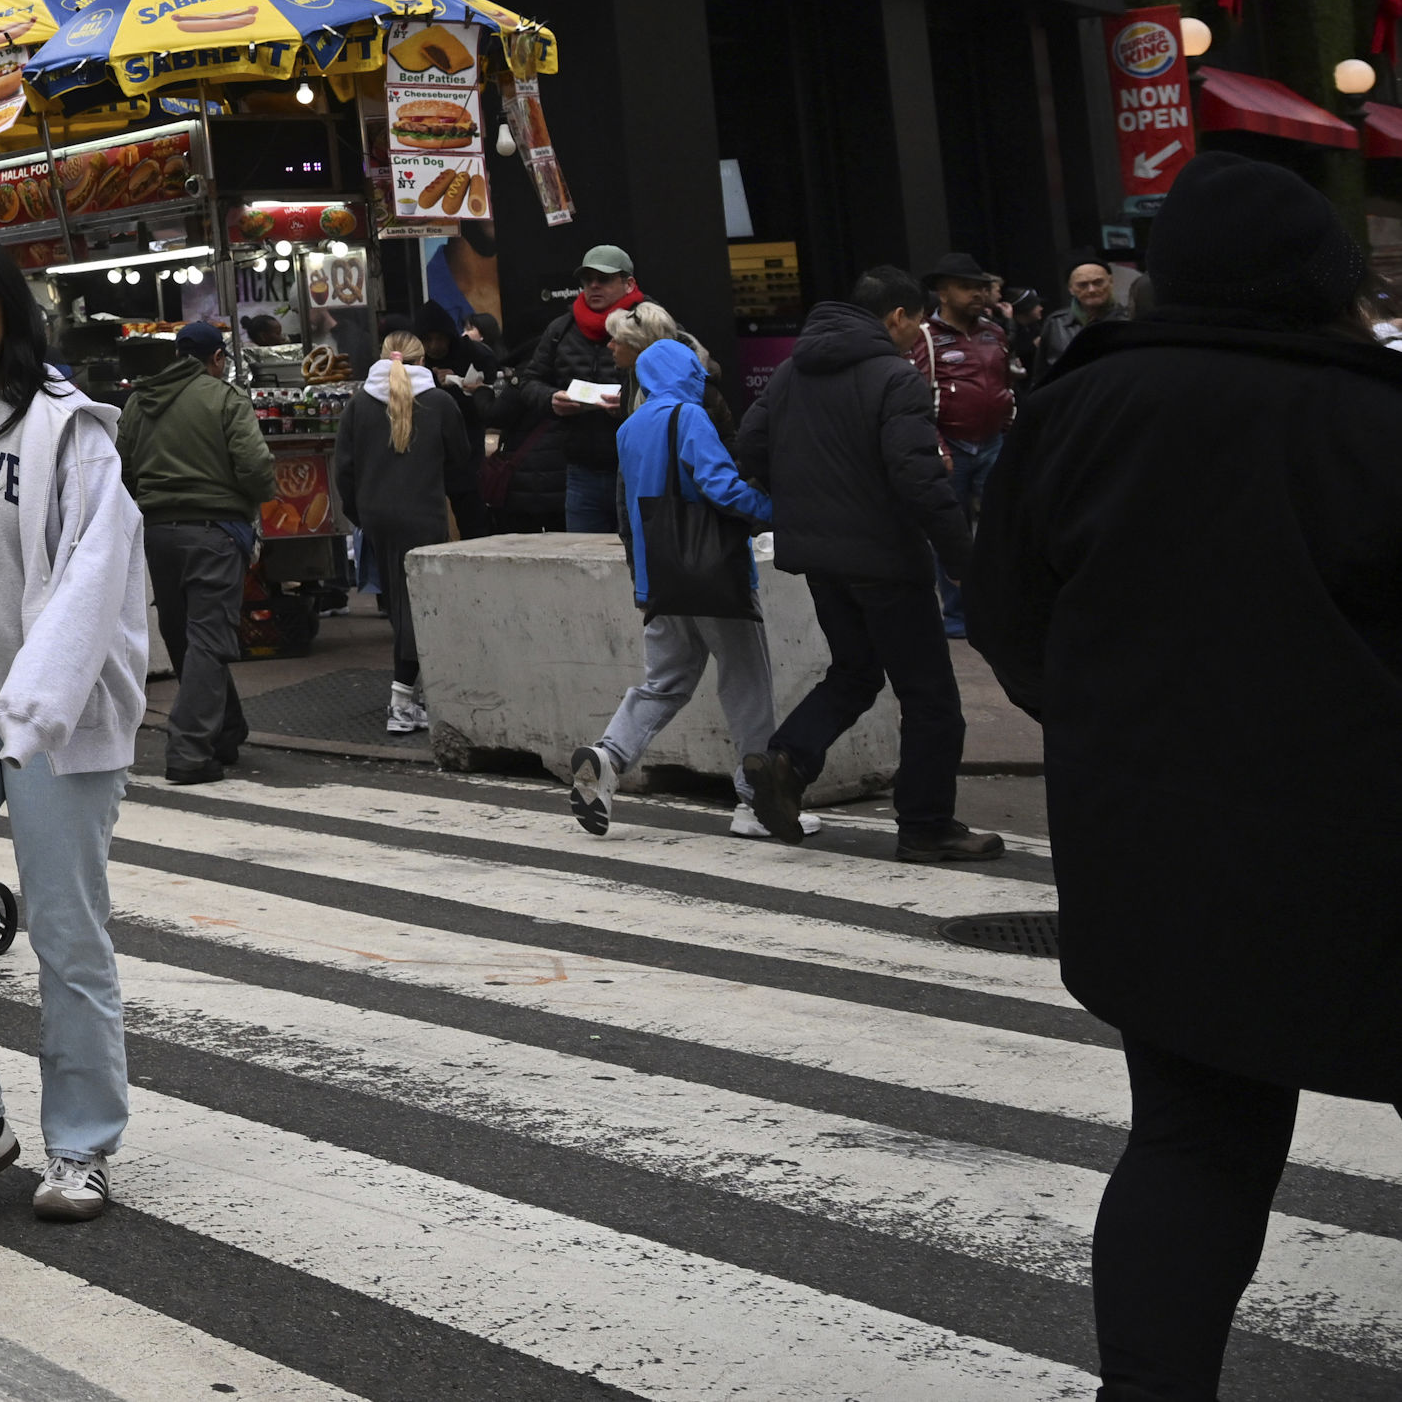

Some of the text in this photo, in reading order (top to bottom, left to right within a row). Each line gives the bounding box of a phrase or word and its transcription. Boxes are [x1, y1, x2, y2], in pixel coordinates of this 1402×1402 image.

[1120, 29, 1167, 55] BURGER
[1123, 40, 1170, 67] KING
[399, 73, 466, 85] Beef Patties
[404, 90, 468, 101] Cheeseburger
[1120, 84, 1181, 109] NOW
[1118, 106, 1188, 132] OPEN
[393, 156, 444, 168] Corn Dog
[0, 167, 29, 182] HALAL
[29, 163, 49, 176] FOO
[397, 179, 416, 190] NY
